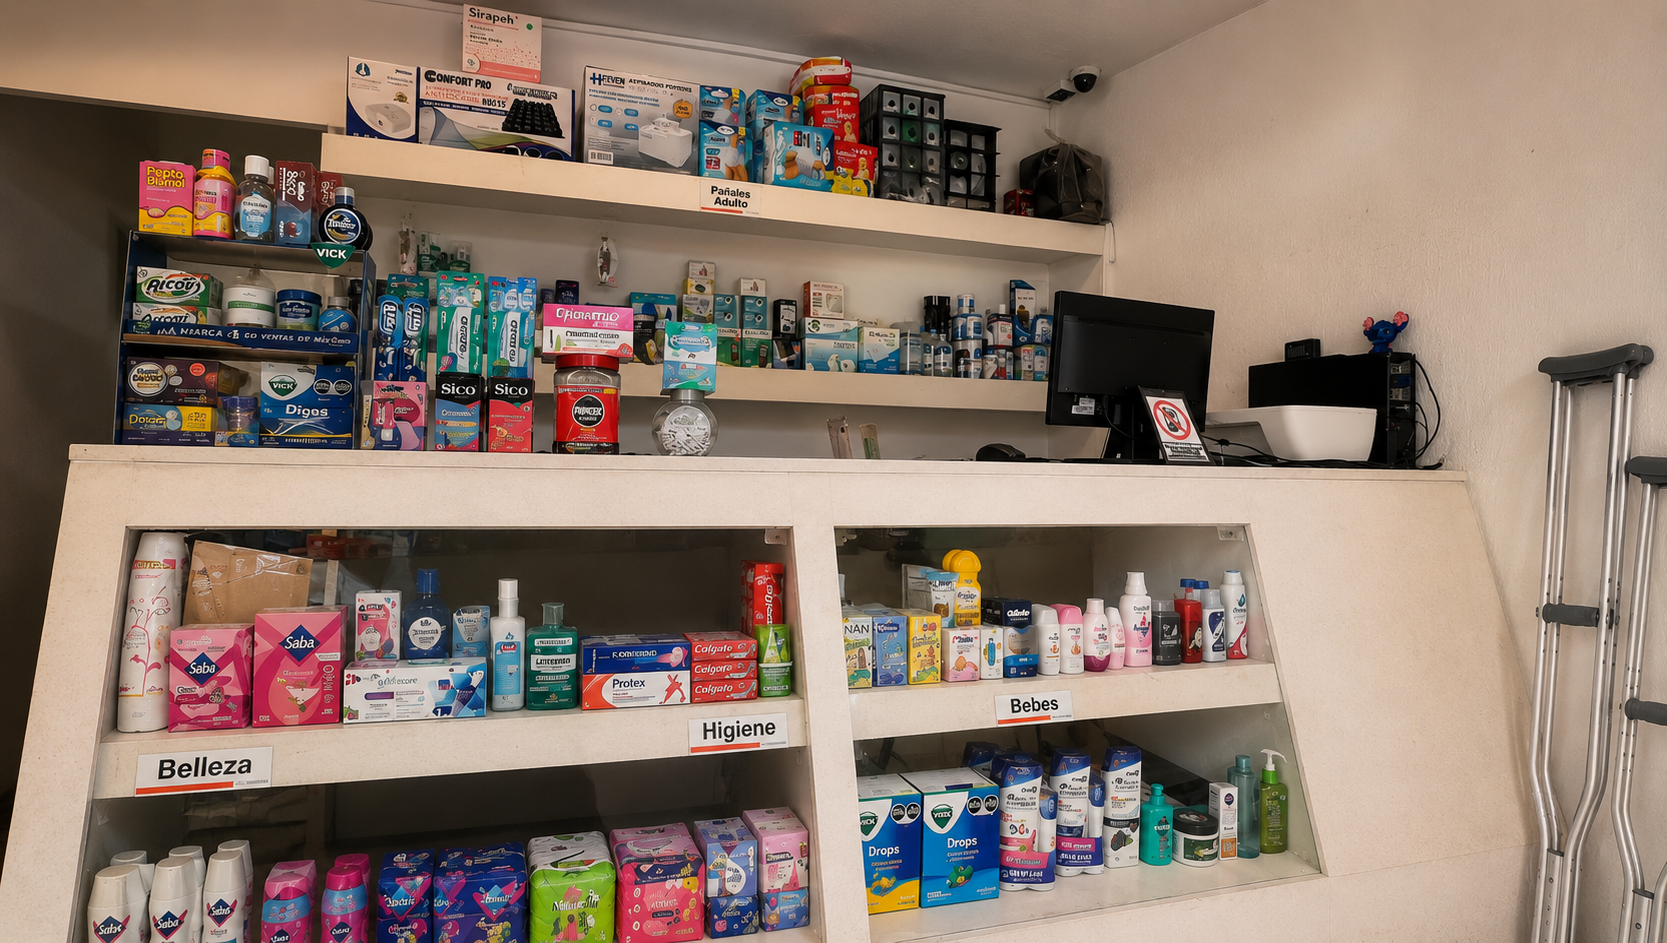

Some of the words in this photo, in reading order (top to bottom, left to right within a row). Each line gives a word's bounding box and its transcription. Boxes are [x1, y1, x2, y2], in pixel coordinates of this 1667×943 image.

[475, 79, 492, 90] PRO
[710, 185, 751, 199] Pañales
[714, 197, 748, 209] Adulto
[316, 248, 347, 259] VICK
[441, 383, 476, 396] Sico
[494, 383, 528, 396] Sico
[844, 624, 870, 635] NAN
[284, 636, 315, 650] Saba
[188, 661, 216, 675] Saba
[612, 678, 646, 690] Protex
[1010, 697, 1059, 714] Bebes
[702, 720, 776, 743] Higiene
[157, 756, 252, 780] Belleza
[947, 837, 978, 849] Drops
[868, 845, 900, 858] Drops
[157, 917, 180, 930] Saba
